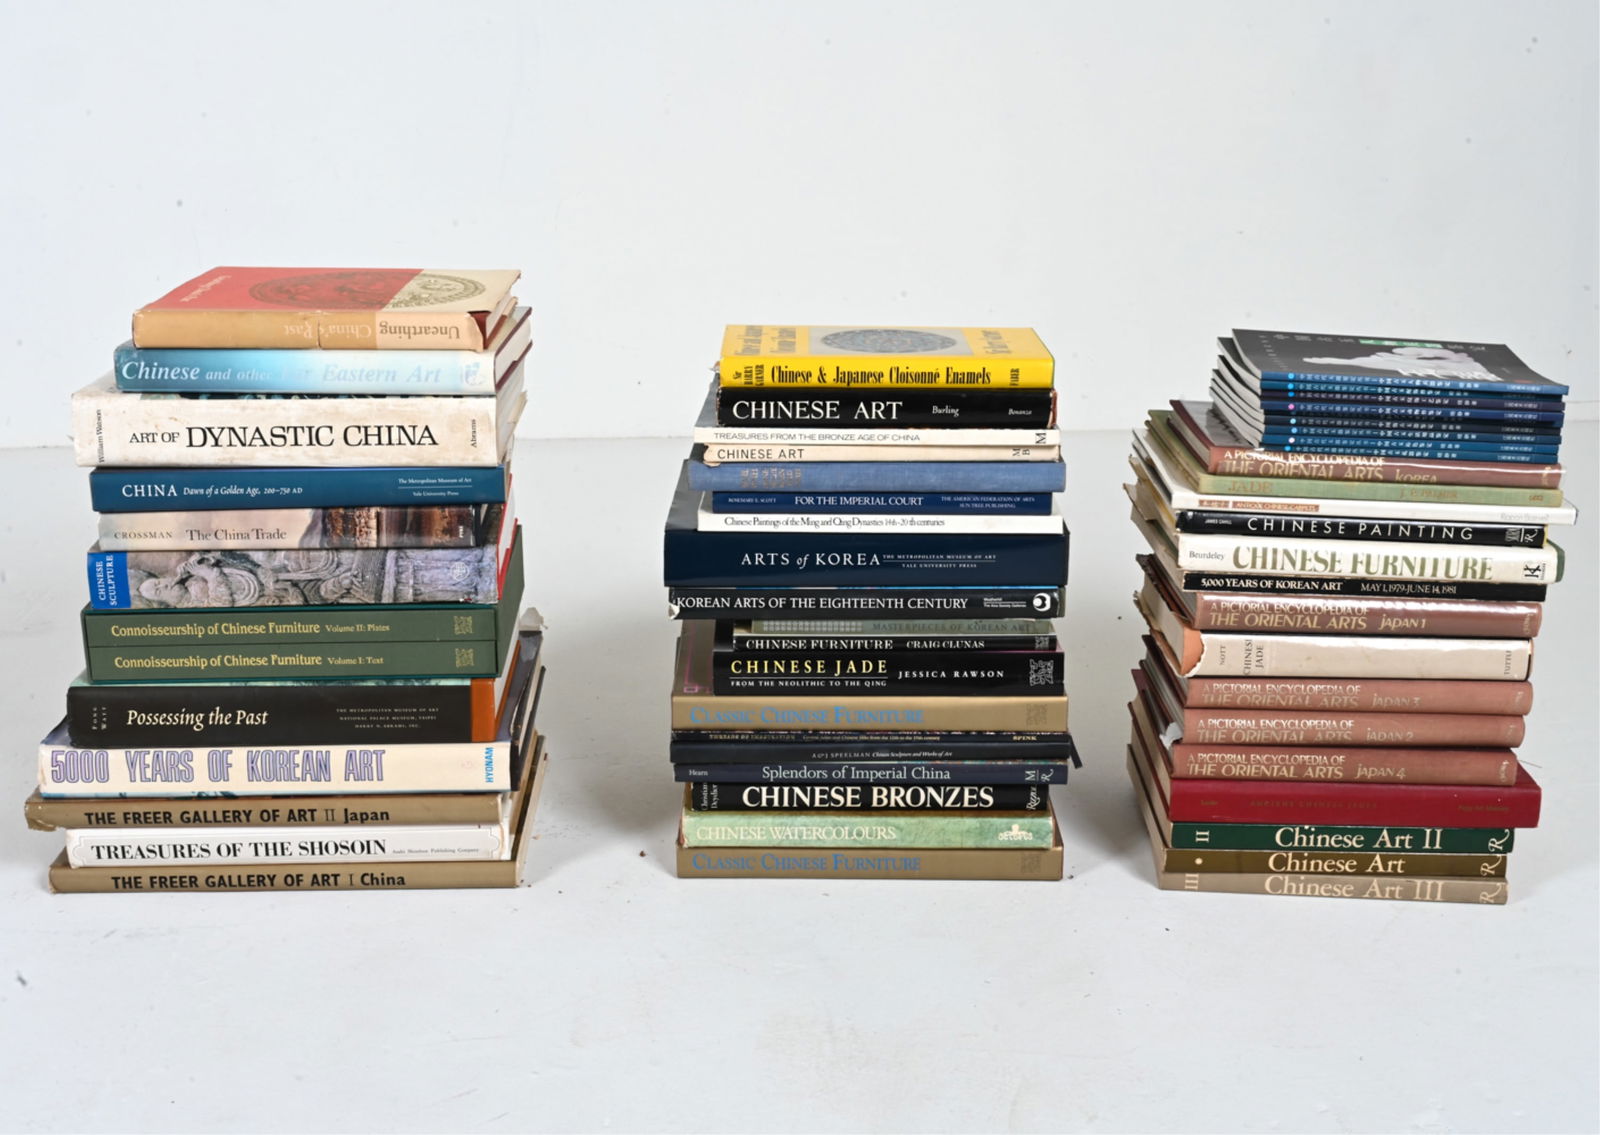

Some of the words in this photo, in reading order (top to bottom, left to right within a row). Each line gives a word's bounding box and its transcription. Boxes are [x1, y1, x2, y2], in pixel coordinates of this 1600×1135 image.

[284, 321, 312, 338] Past
[380, 321, 460, 339] Unearthing
[122, 361, 200, 380] Chinese
[206, 368, 230, 380] and
[323, 364, 396, 382] Eastern
[406, 365, 441, 382] Art
[771, 365, 812, 383] Chinese
[818, 366, 827, 383] &
[833, 366, 884, 386] Japanese
[889, 366, 940, 384] Cloisonné
[946, 366, 991, 384] Enamels
[732, 400, 840, 419] CHINESE
[854, 401, 902, 419] ART
[130, 432, 158, 443] ART
[161, 432, 179, 443] OF
[186, 425, 334, 447] DYNASTIC
[343, 425, 439, 446] CHINA
[714, 432, 768, 440] TREASURES
[770, 433, 796, 441] FROM
[799, 433, 816, 441] THE
[818, 433, 855, 441] BRONZE
[717, 449, 773, 459] CHINESE
[778, 449, 805, 459] ART
[122, 484, 177, 497] CHINA
[183, 487, 204, 495] Dawn
[205, 485, 213, 497] of
[220, 485, 244, 496] Golden
[246, 486, 261, 497] Age,
[1229, 480, 1273, 493] JADE
[794, 496, 815, 505] FOR
[816, 497, 838, 505] THE
[840, 496, 886, 505] IMPERIAL
[889, 497, 924, 506] COURT
[724, 516, 752, 526] Chinese
[753, 517, 782, 528] Paintings
[782, 517, 790, 526] of
[790, 517, 800, 526] the
[801, 517, 820, 528] Ming
[820, 517, 832, 526] and
[832, 517, 851, 528] Qing
[852, 517, 884, 528] Dynasties
[1247, 517, 1345, 535] CHINESE
[1358, 521, 1473, 540] PAINTING
[114, 531, 173, 540] CROSSMAN
[186, 529, 211, 541] The
[214, 528, 250, 540] China
[251, 528, 287, 540] Trade
[741, 553, 790, 566] ARTS
[796, 554, 810, 569] of
[815, 553, 880, 566] KOREA
[1189, 551, 1225, 560] Beurdeley
[1232, 546, 1342, 573] CHINESE
[1350, 552, 1494, 580] FURNITURE
[96, 561, 106, 600] CHINESE
[106, 555, 118, 606] SCULPTURE
[1200, 578, 1224, 588] 5,000
[1225, 579, 1258, 588] YEARS
[1260, 580, 1273, 588] OF
[1275, 580, 1319, 590] KOREAN
[1321, 582, 1343, 590] ART
[677, 597, 730, 608] KOREAN
[733, 597, 765, 609] ARTS
[768, 597, 787, 609] OF
[789, 597, 816, 609] THE
[819, 597, 903, 609] EIGHTEENTH
[907, 598, 968, 609] CENTURY
[1211, 603, 1218, 612] A
[1221, 602, 1272, 613] PICTORIAL
[1274, 603, 1353, 615] ENCYCLOPEDIA
[1356, 605, 1369, 615] OF
[111, 623, 205, 638] Connoisseurship
[207, 623, 219, 635] of
[221, 622, 266, 635] Chinese
[268, 621, 320, 634] Furniture
[325, 624, 355, 633] Volume
[367, 624, 390, 632] Plates
[873, 623, 946, 632] MASTERPIECES
[950, 623, 963, 632] OF
[967, 623, 1008, 632] KOREAN
[1010, 623, 1030, 632] ART
[1210, 612, 1240, 627] THE
[1244, 614, 1321, 629] ORIENTAL
[1328, 616, 1367, 630] ARTS
[1420, 618, 1426, 628] 1
[746, 639, 807, 649] CHINESE
[811, 640, 893, 649] FURNITURE
[906, 640, 941, 649] CRAIG
[942, 640, 985, 649] CLUNAS
[1255, 645, 1264, 668] JADE
[731, 660, 826, 674] CHINESE
[834, 660, 887, 676] JADE
[898, 671, 946, 679] JESSICA
[127, 708, 204, 731] Possessing
[208, 706, 231, 726] the
[236, 709, 269, 726] Past
[51, 750, 110, 783] 5000
[125, 750, 195, 783] YEARS
[207, 750, 233, 783] OF
[247, 750, 331, 783] KOREAN
[344, 750, 386, 783] ART
[485, 747, 493, 783] HYONAM
[762, 766, 828, 782] Splendors
[832, 766, 848, 778] of
[851, 766, 907, 782] Imperial
[911, 766, 950, 779] China
[742, 786, 861, 807] CHINESE
[872, 786, 994, 808] BRONZES
[696, 826, 766, 840] CHINESE
[769, 826, 896, 840] WATERCOLOURS
[1275, 826, 1364, 848] Chinese
[1372, 829, 1413, 849] Art
[1422, 828, 1443, 849] II
[91, 843, 211, 860] TREASURES
[216, 842, 243, 858] OF
[249, 841, 292, 857] THE
[298, 839, 386, 856] SHOSOIN
[1268, 852, 1357, 873] Chinese
[1365, 854, 1406, 874] Art
[1264, 875, 1354, 897] Chinese
[1363, 878, 1404, 899] Art
[1414, 879, 1444, 901] III
